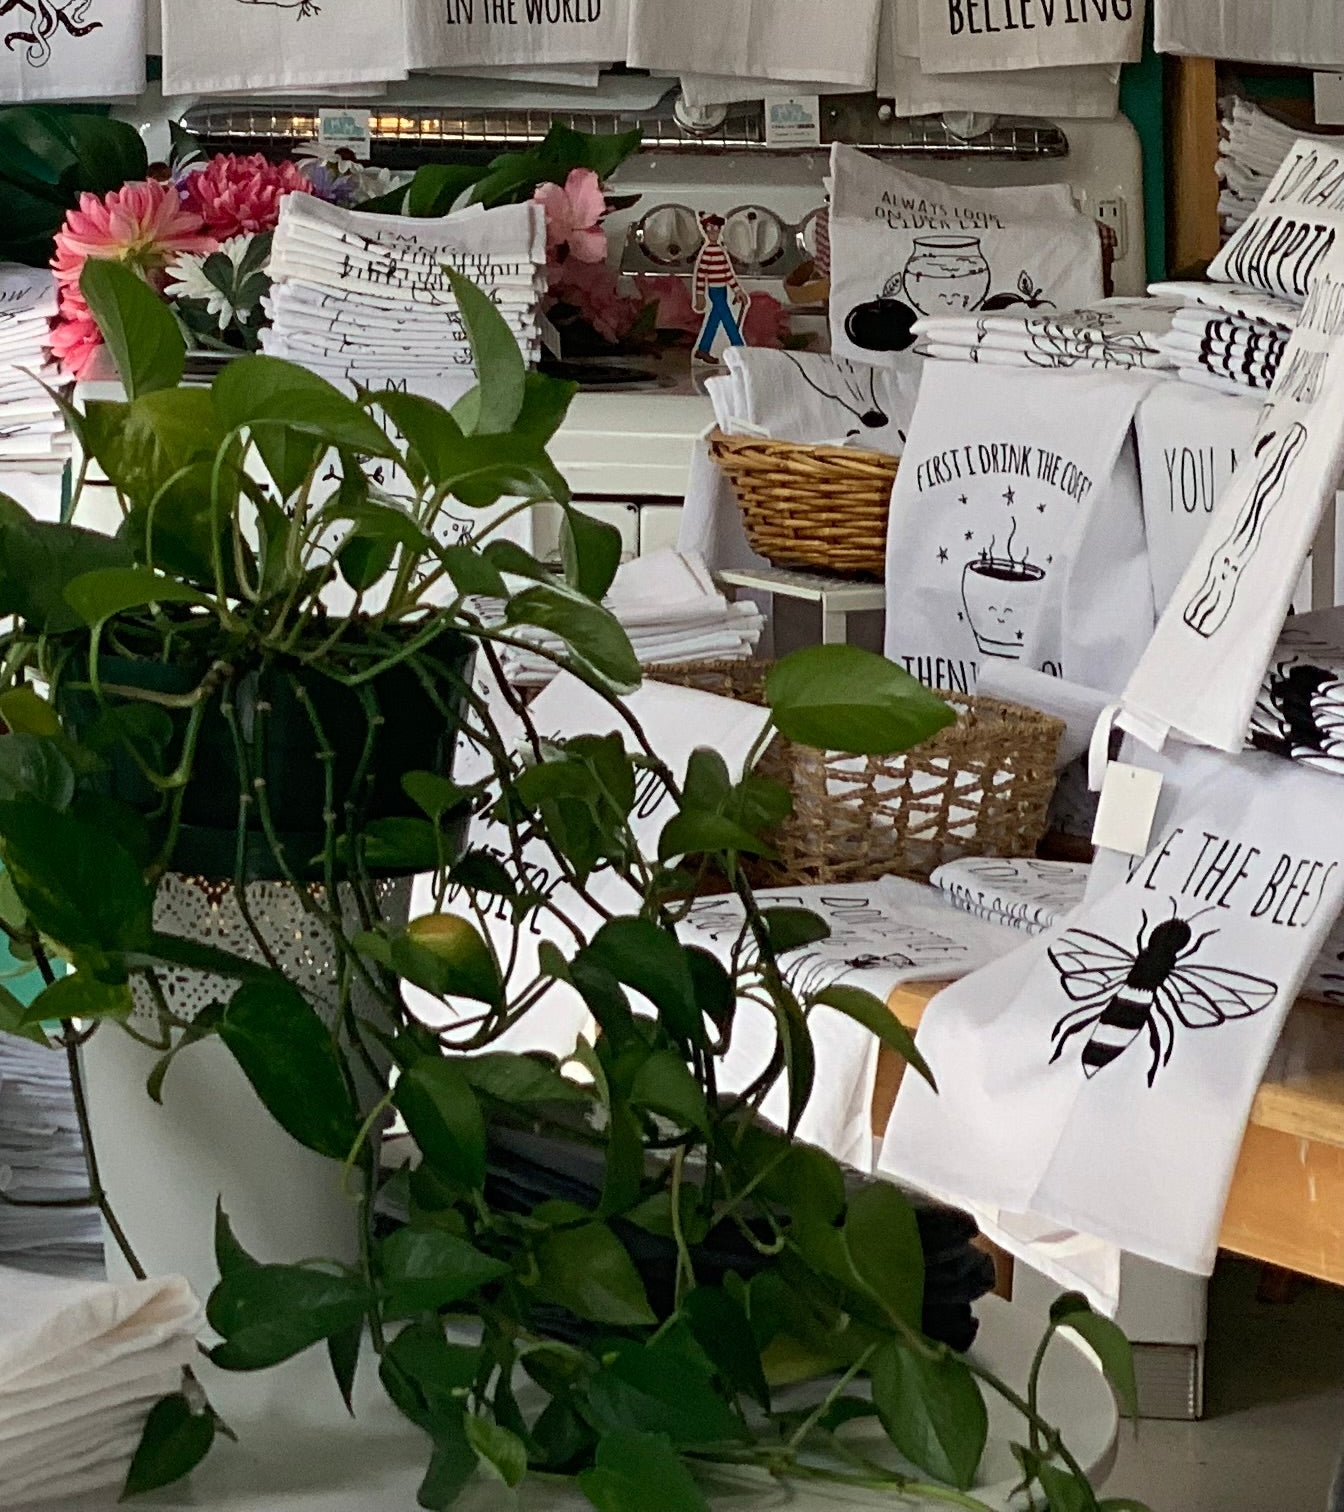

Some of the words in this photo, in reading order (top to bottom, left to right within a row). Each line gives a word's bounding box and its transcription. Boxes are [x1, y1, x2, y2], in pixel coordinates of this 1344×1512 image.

[915, 445, 963, 493] FIRST
[963, 445, 974, 477] I
[978, 441, 1031, 479] DRINK
[1035, 447, 1062, 482] THE
[1165, 445, 1215, 515] YOU
[1182, 833, 1250, 910] THE
[1252, 854, 1339, 929] BEES
